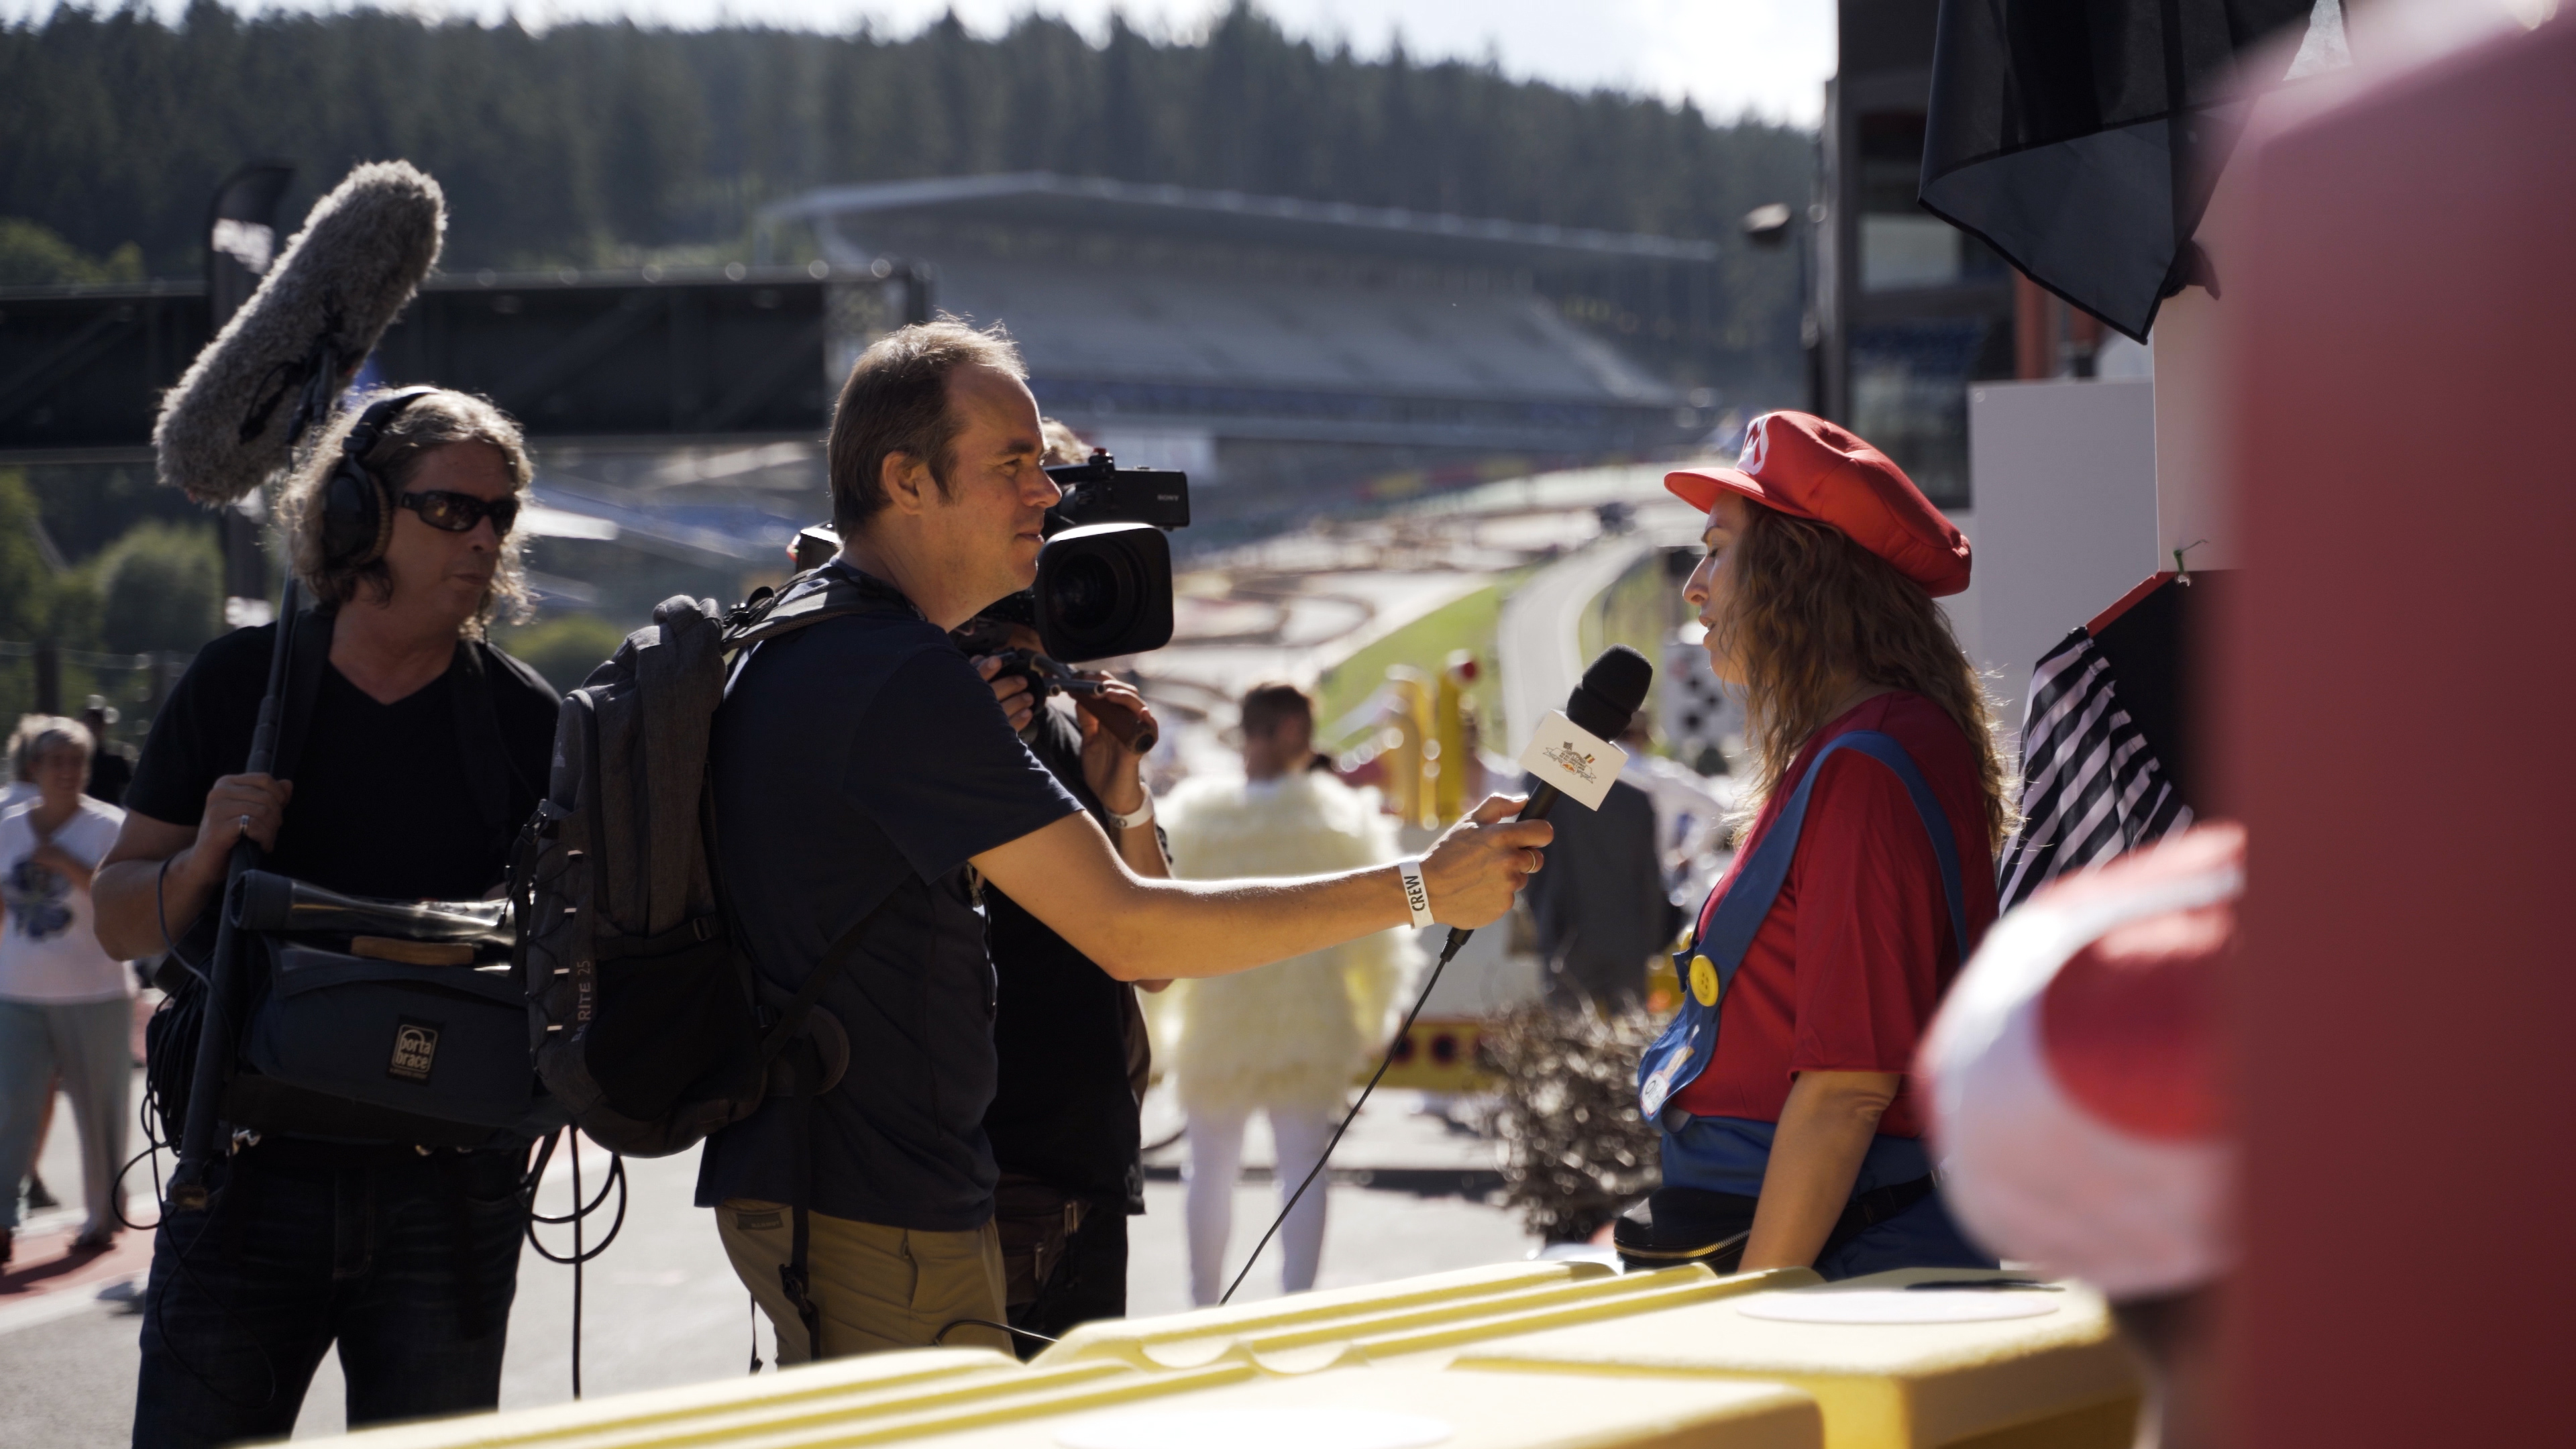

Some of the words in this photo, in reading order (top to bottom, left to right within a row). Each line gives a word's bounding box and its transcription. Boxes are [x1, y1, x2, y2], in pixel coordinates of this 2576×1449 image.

[1157, 494, 1180, 502] SONY
[1403, 875, 1426, 912] CREW
[577, 960, 591, 975] 25
[398, 1033, 432, 1055] porta
[394, 1052, 429, 1071] brace
